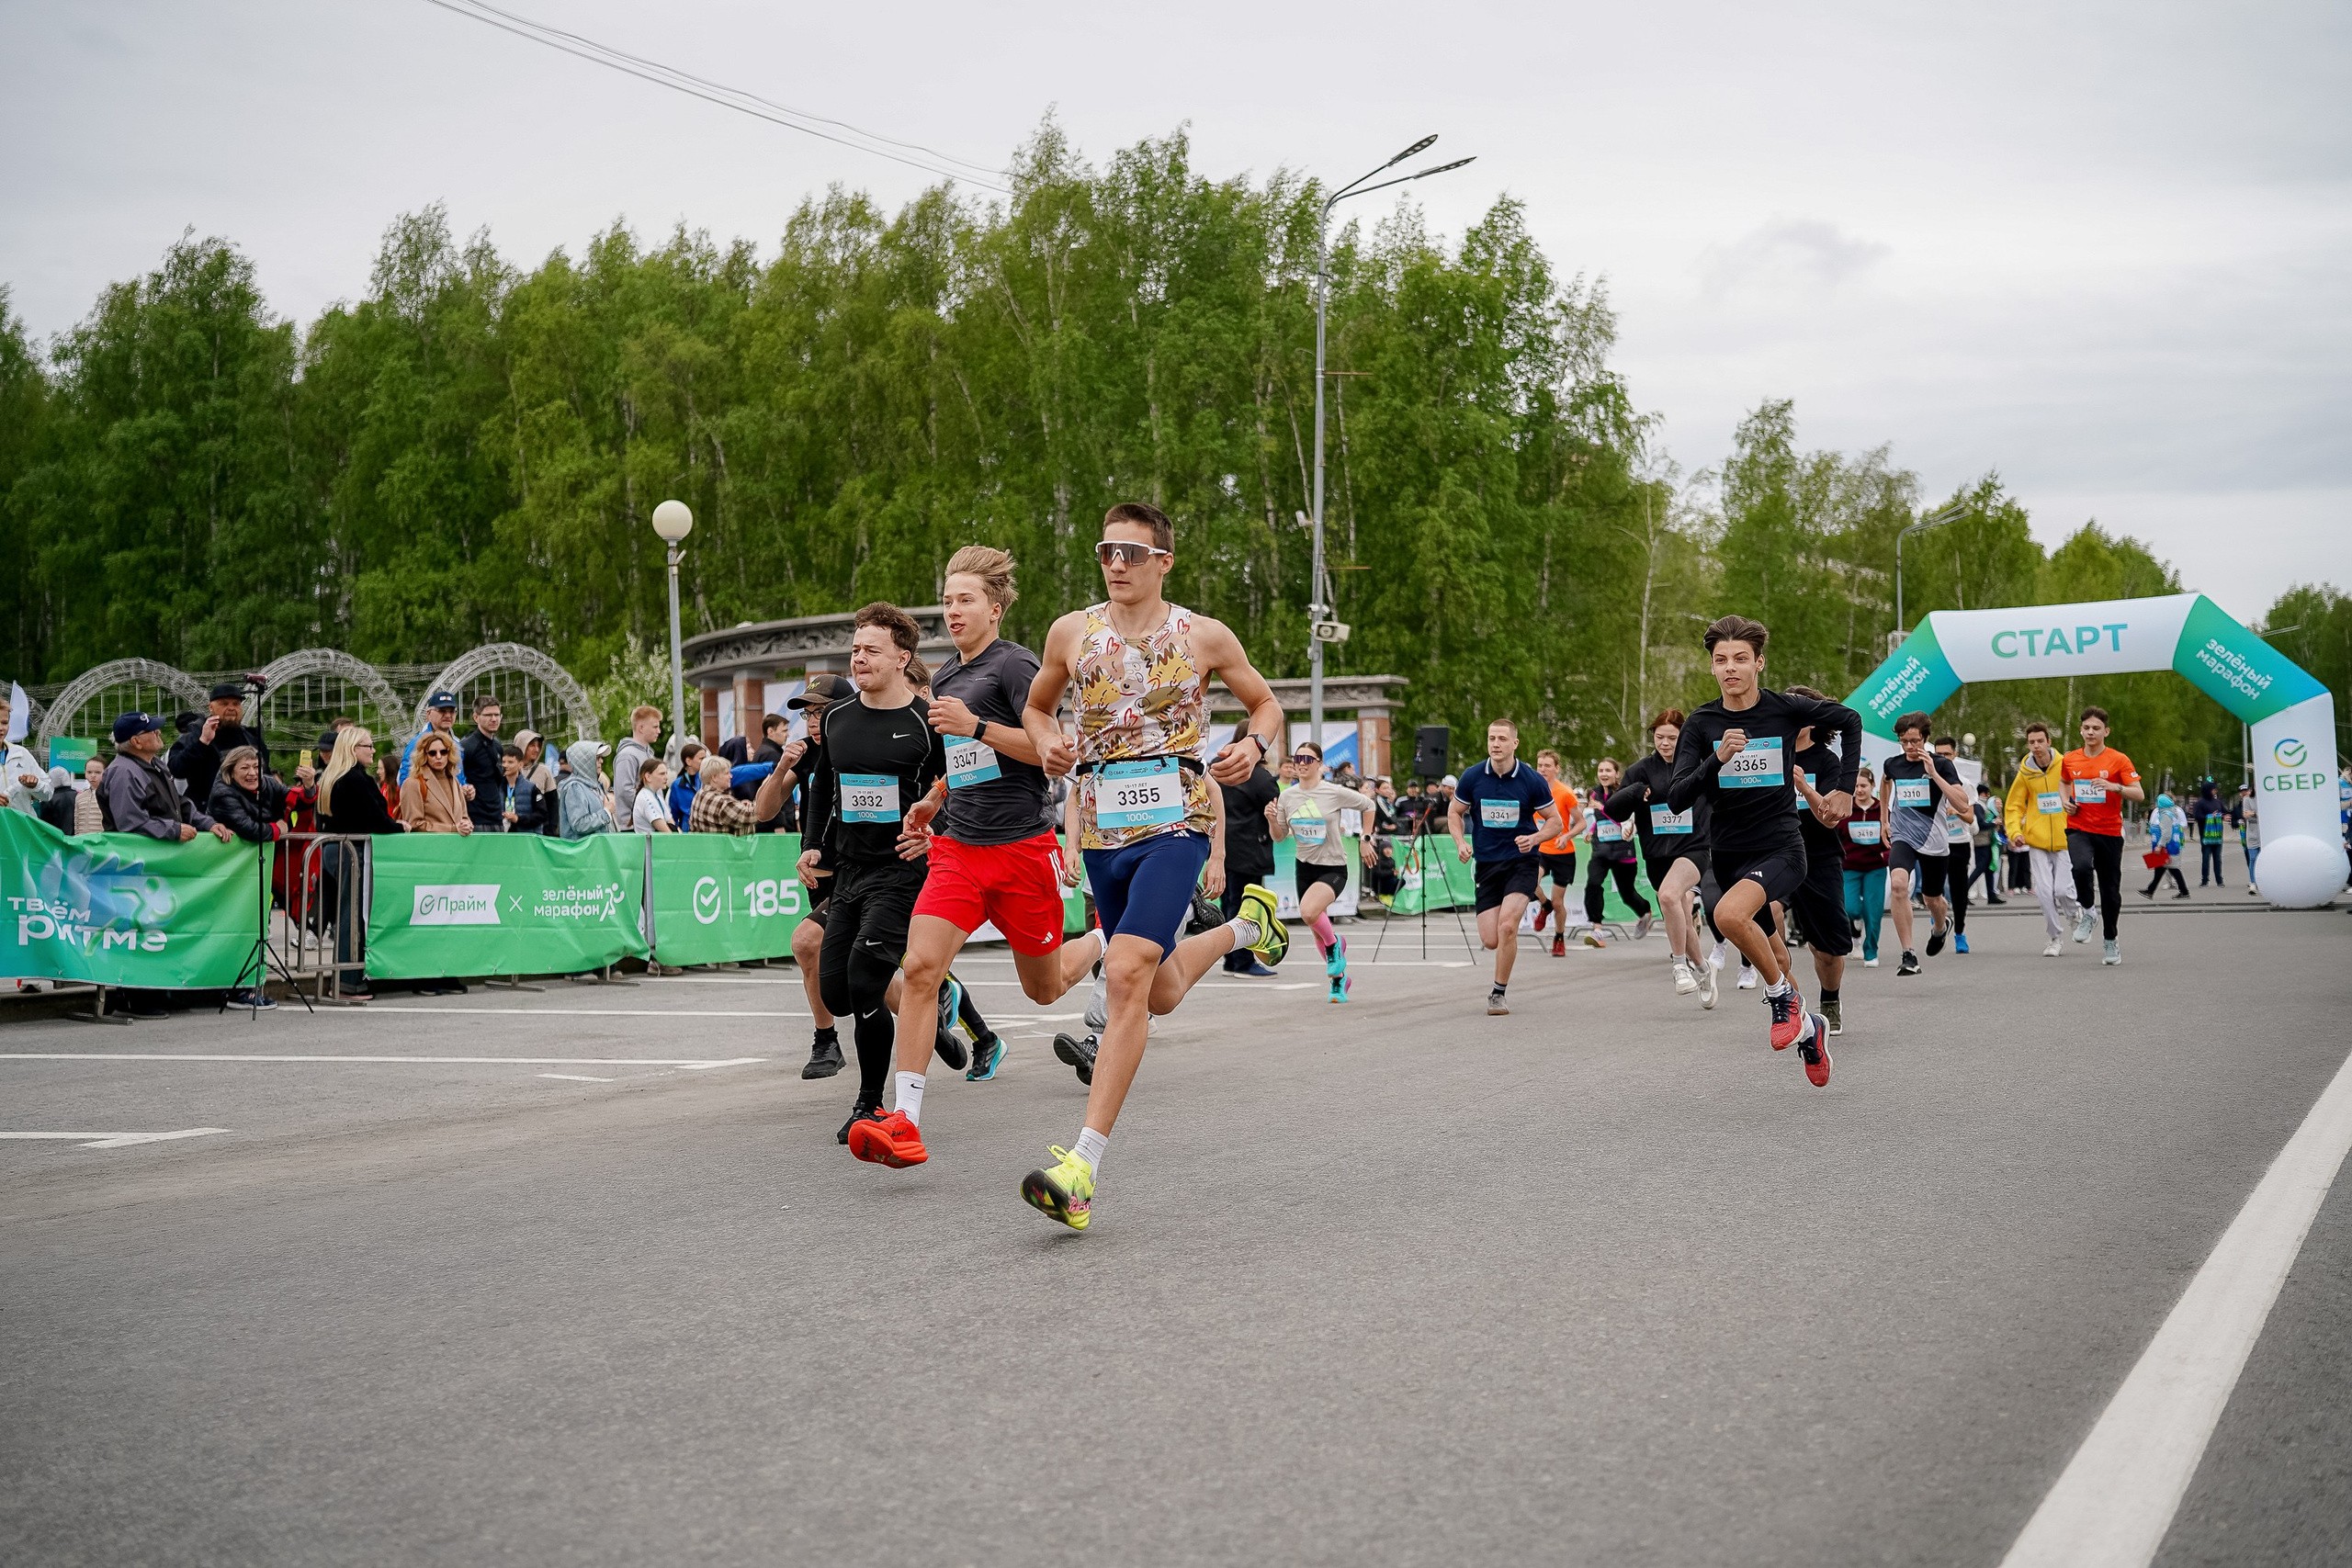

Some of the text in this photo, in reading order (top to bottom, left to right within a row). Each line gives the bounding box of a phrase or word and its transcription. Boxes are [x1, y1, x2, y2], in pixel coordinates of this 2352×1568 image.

[1991, 623, 2129, 659] СТАРТ
[2206, 638, 2274, 690] зелёный
[1868, 655, 1921, 711] зелёный
[2195, 649, 2261, 701] марафон
[1876, 666, 1930, 720] марафон
[953, 751, 978, 769] 3347
[1734, 758, 1767, 773] 3365
[2263, 773, 2326, 792] СБЕР
[852, 795, 883, 807] 3332
[1117, 787, 1160, 807] 3355
[1903, 790, 1921, 798] 3310
[1125, 812, 1155, 822] 1000м
[1490, 811, 1510, 820] 3341
[1662, 816, 1682, 824] 3377
[542, 885, 604, 902] зелёный
[743, 878, 801, 918] 185
[7, 897, 92, 923] твём
[437, 896, 487, 915] Прайм
[534, 901, 600, 920] марафон
